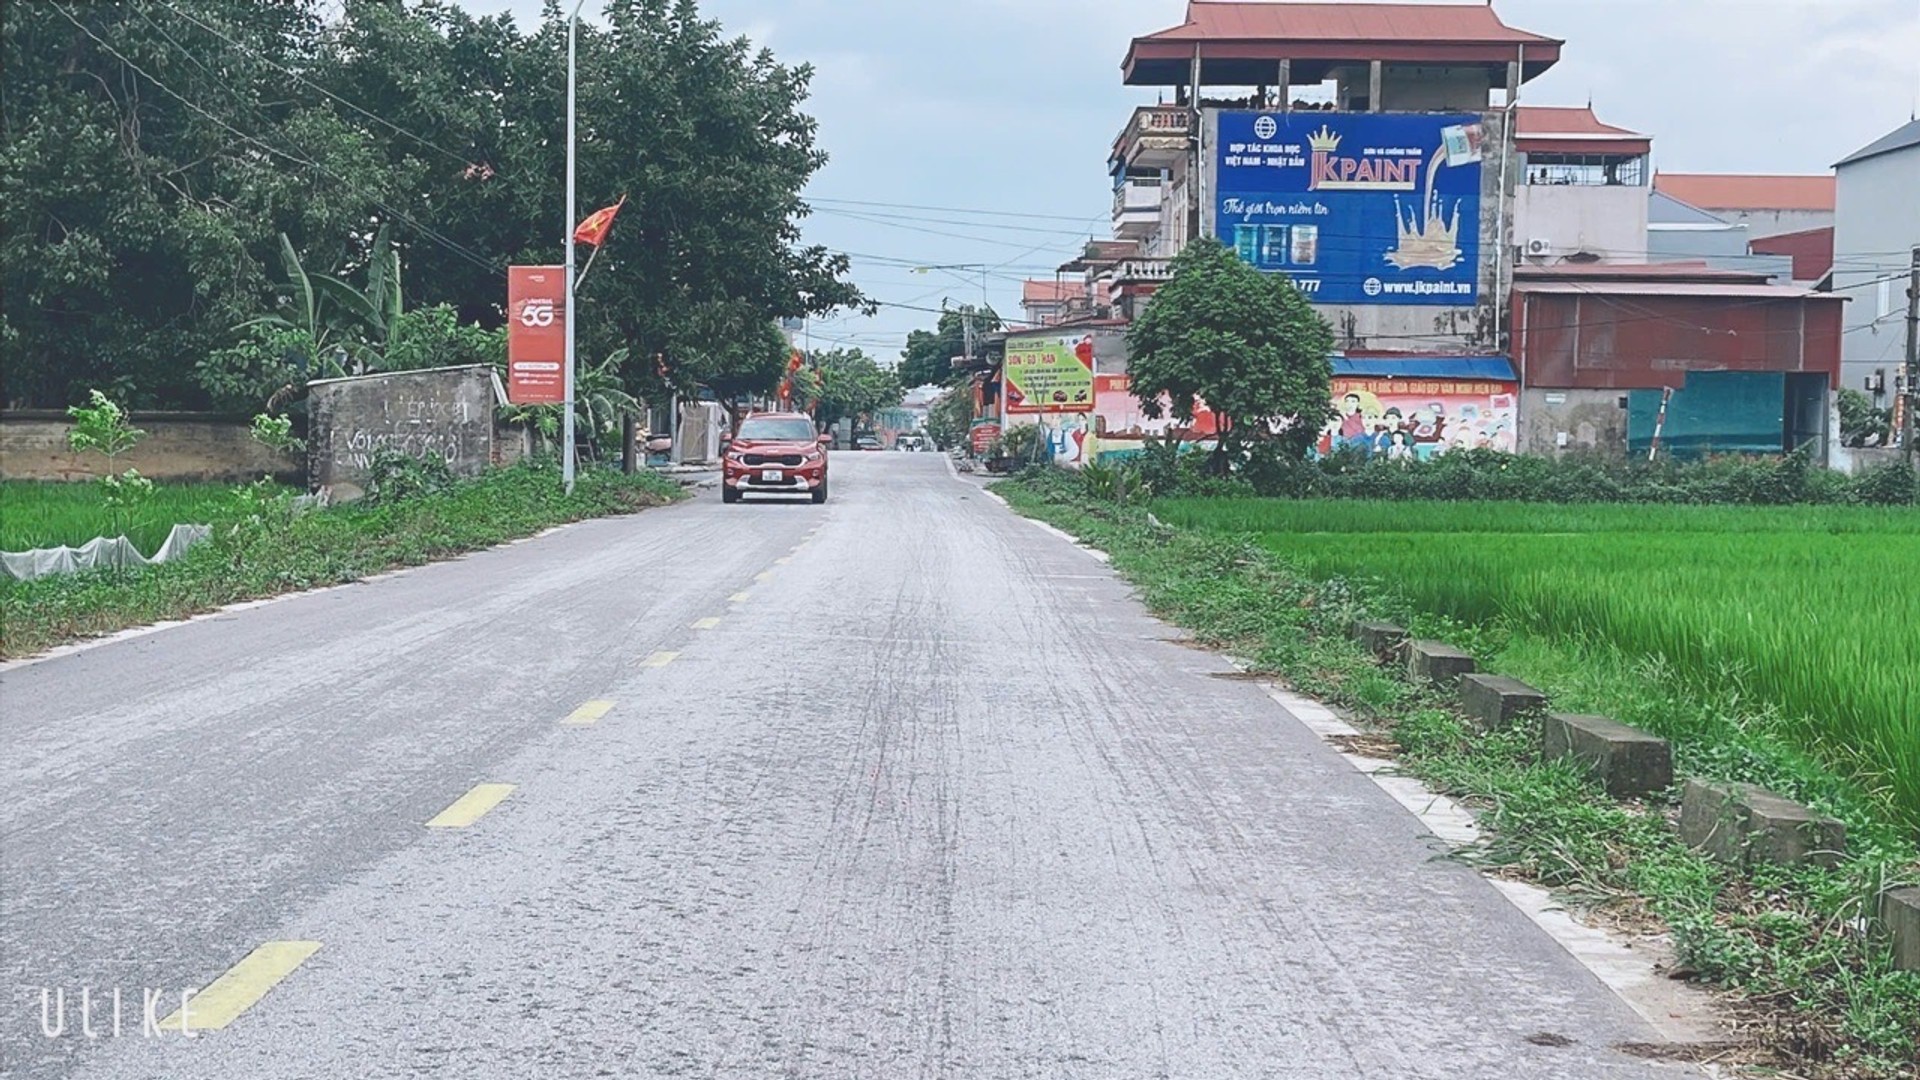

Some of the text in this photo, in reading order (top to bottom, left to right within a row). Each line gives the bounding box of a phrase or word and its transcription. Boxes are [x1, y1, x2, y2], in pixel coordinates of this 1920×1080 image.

[1230, 142, 1301, 154] HỢP TÁC KHOA HỌC
[1225, 155, 1241, 167] VIỆT
[1242, 156, 1261, 166] NAM
[1267, 156, 1287, 168] NHẬT
[1288, 155, 1305, 166] BẢN
[1223, 198, 1329, 222] Thế giới trọn niềm tin
[1299, 279, 1321, 292] 777
[1383, 280, 1471, 295] www.jkpaint.vn
[522, 305, 553, 327] 5G
